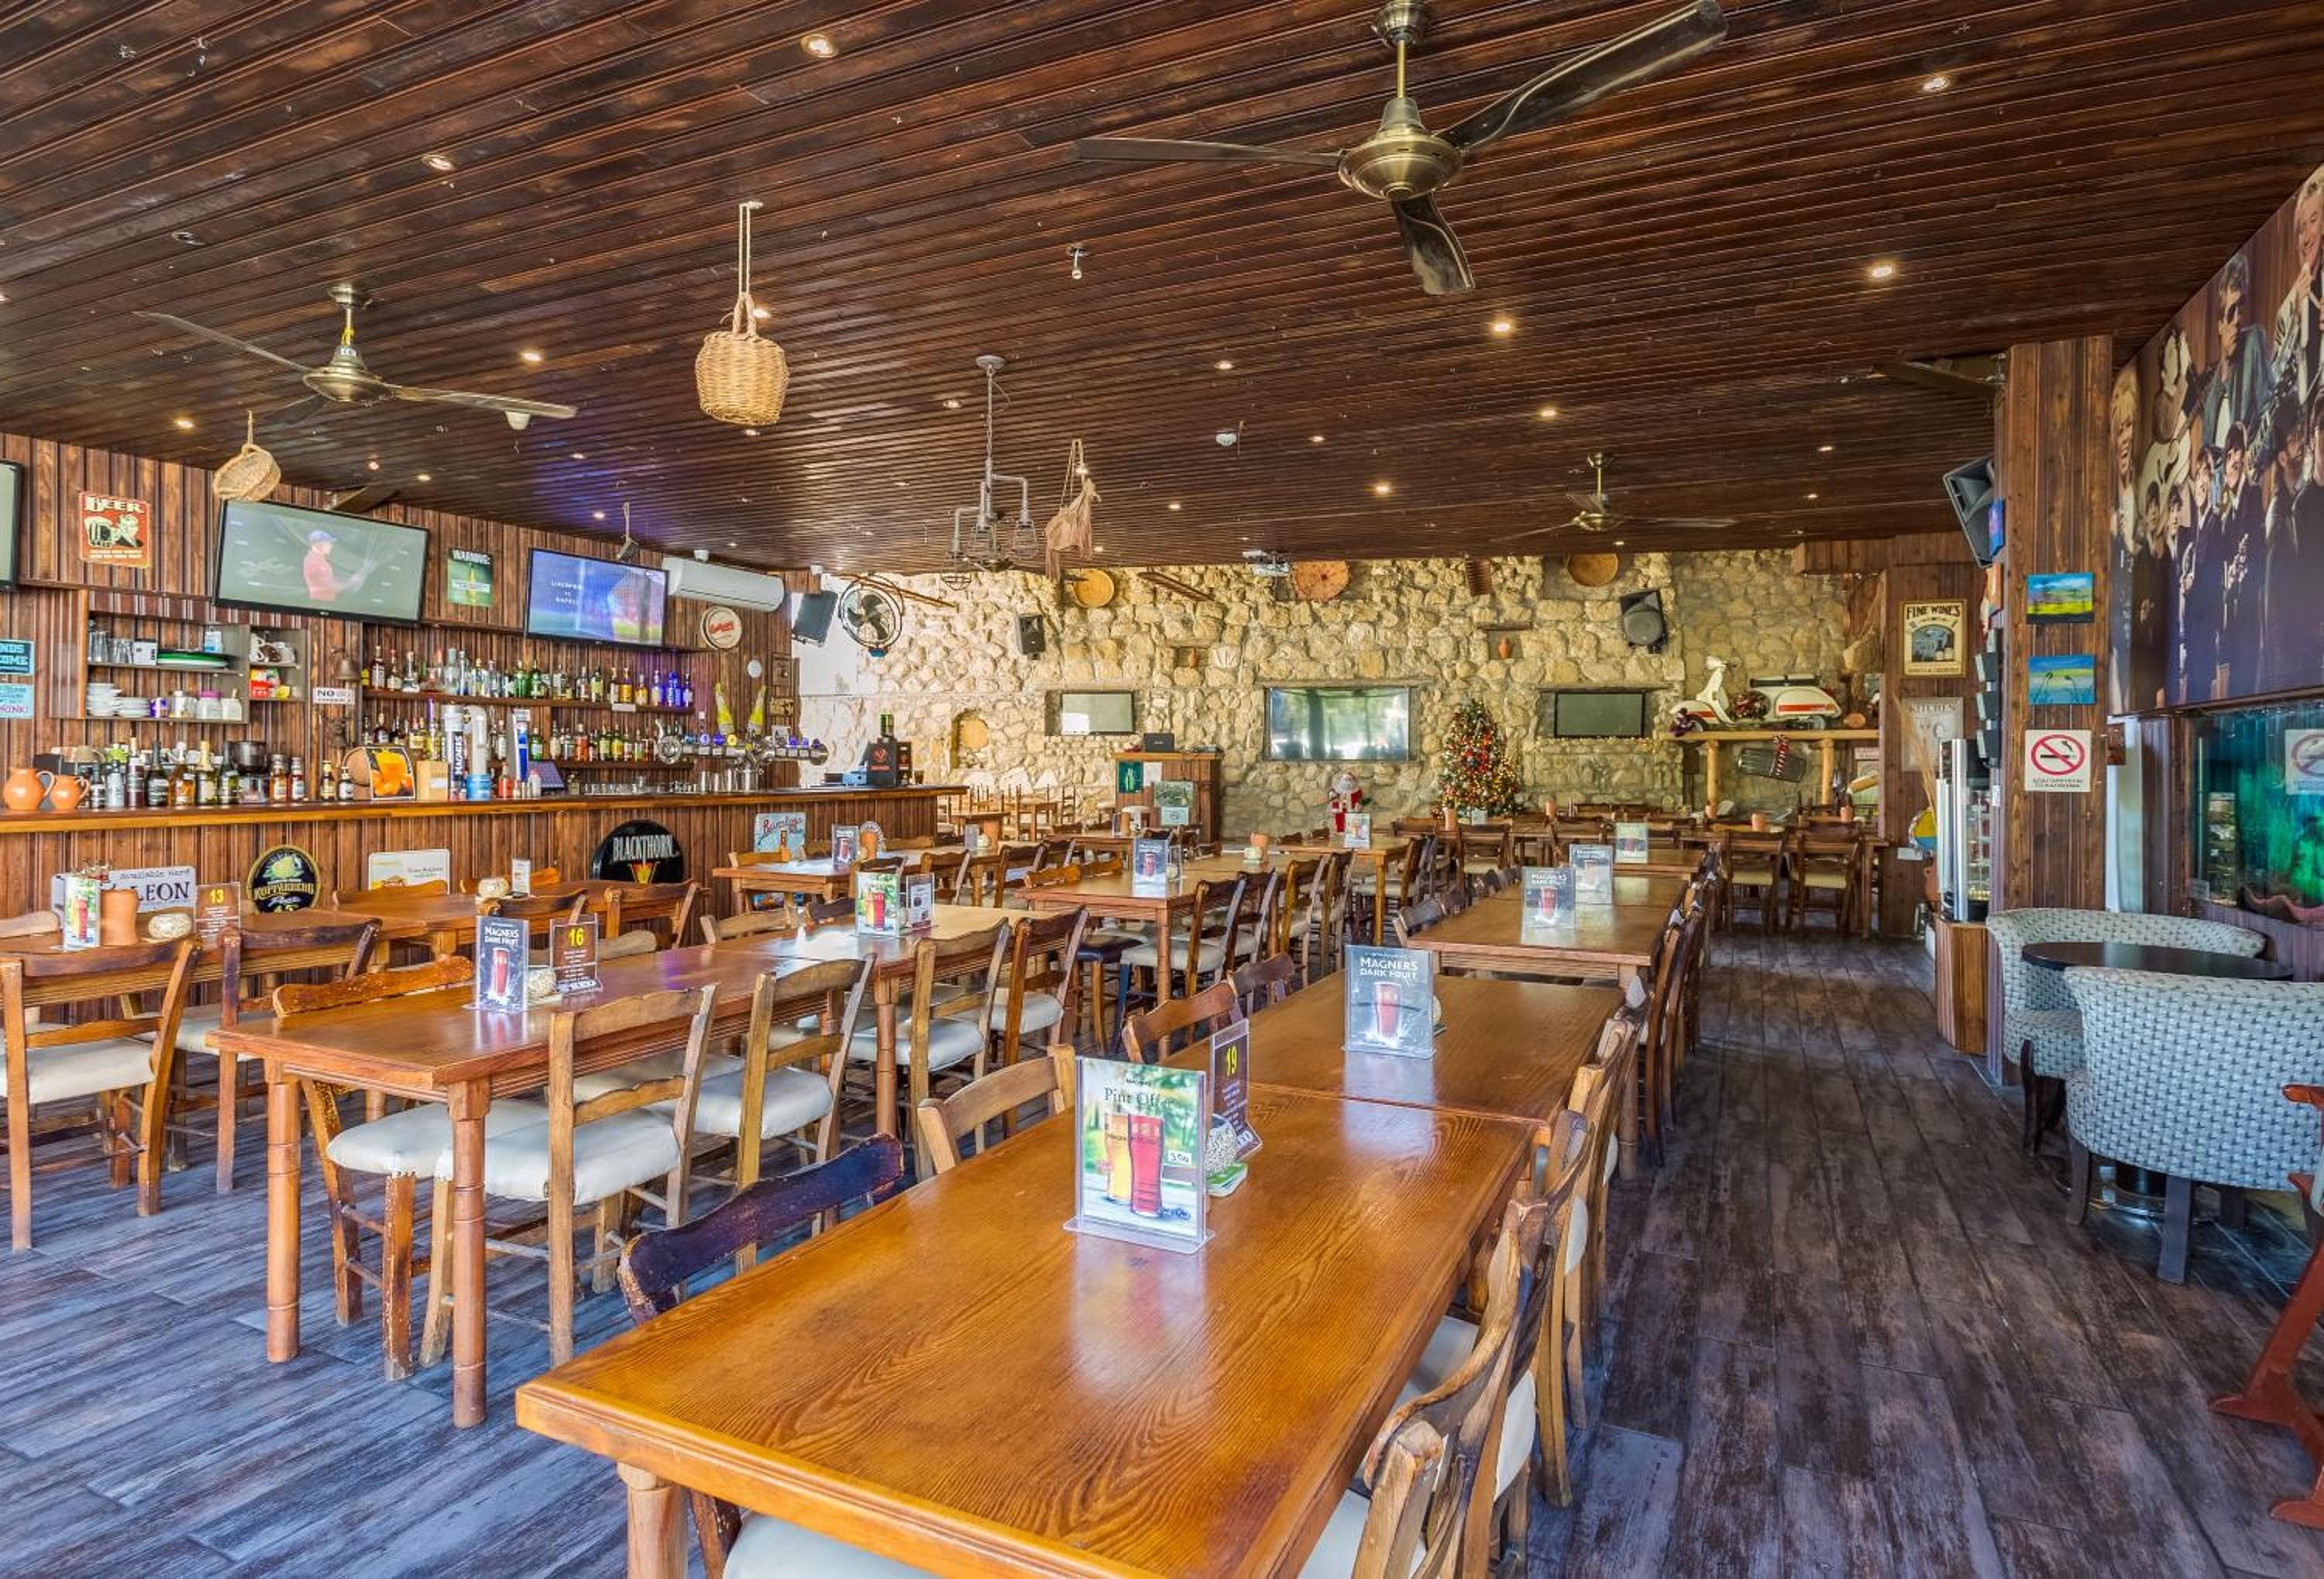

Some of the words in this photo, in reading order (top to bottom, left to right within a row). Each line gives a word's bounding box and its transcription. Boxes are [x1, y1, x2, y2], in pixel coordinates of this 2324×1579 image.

[84, 496, 144, 513] BEER
[1906, 606, 1928, 620] FINE
[610, 834, 676, 862] BLACKTHORN
[209, 889, 225, 904] 13
[569, 927, 584, 946] 16
[1360, 956, 1418, 971] MAGNERS
[1360, 968, 1387, 977] DARK
[1389, 970, 1416, 980] FRUIT
[1226, 1046, 1238, 1076] 19
[1104, 1086, 1132, 1104] Pint
